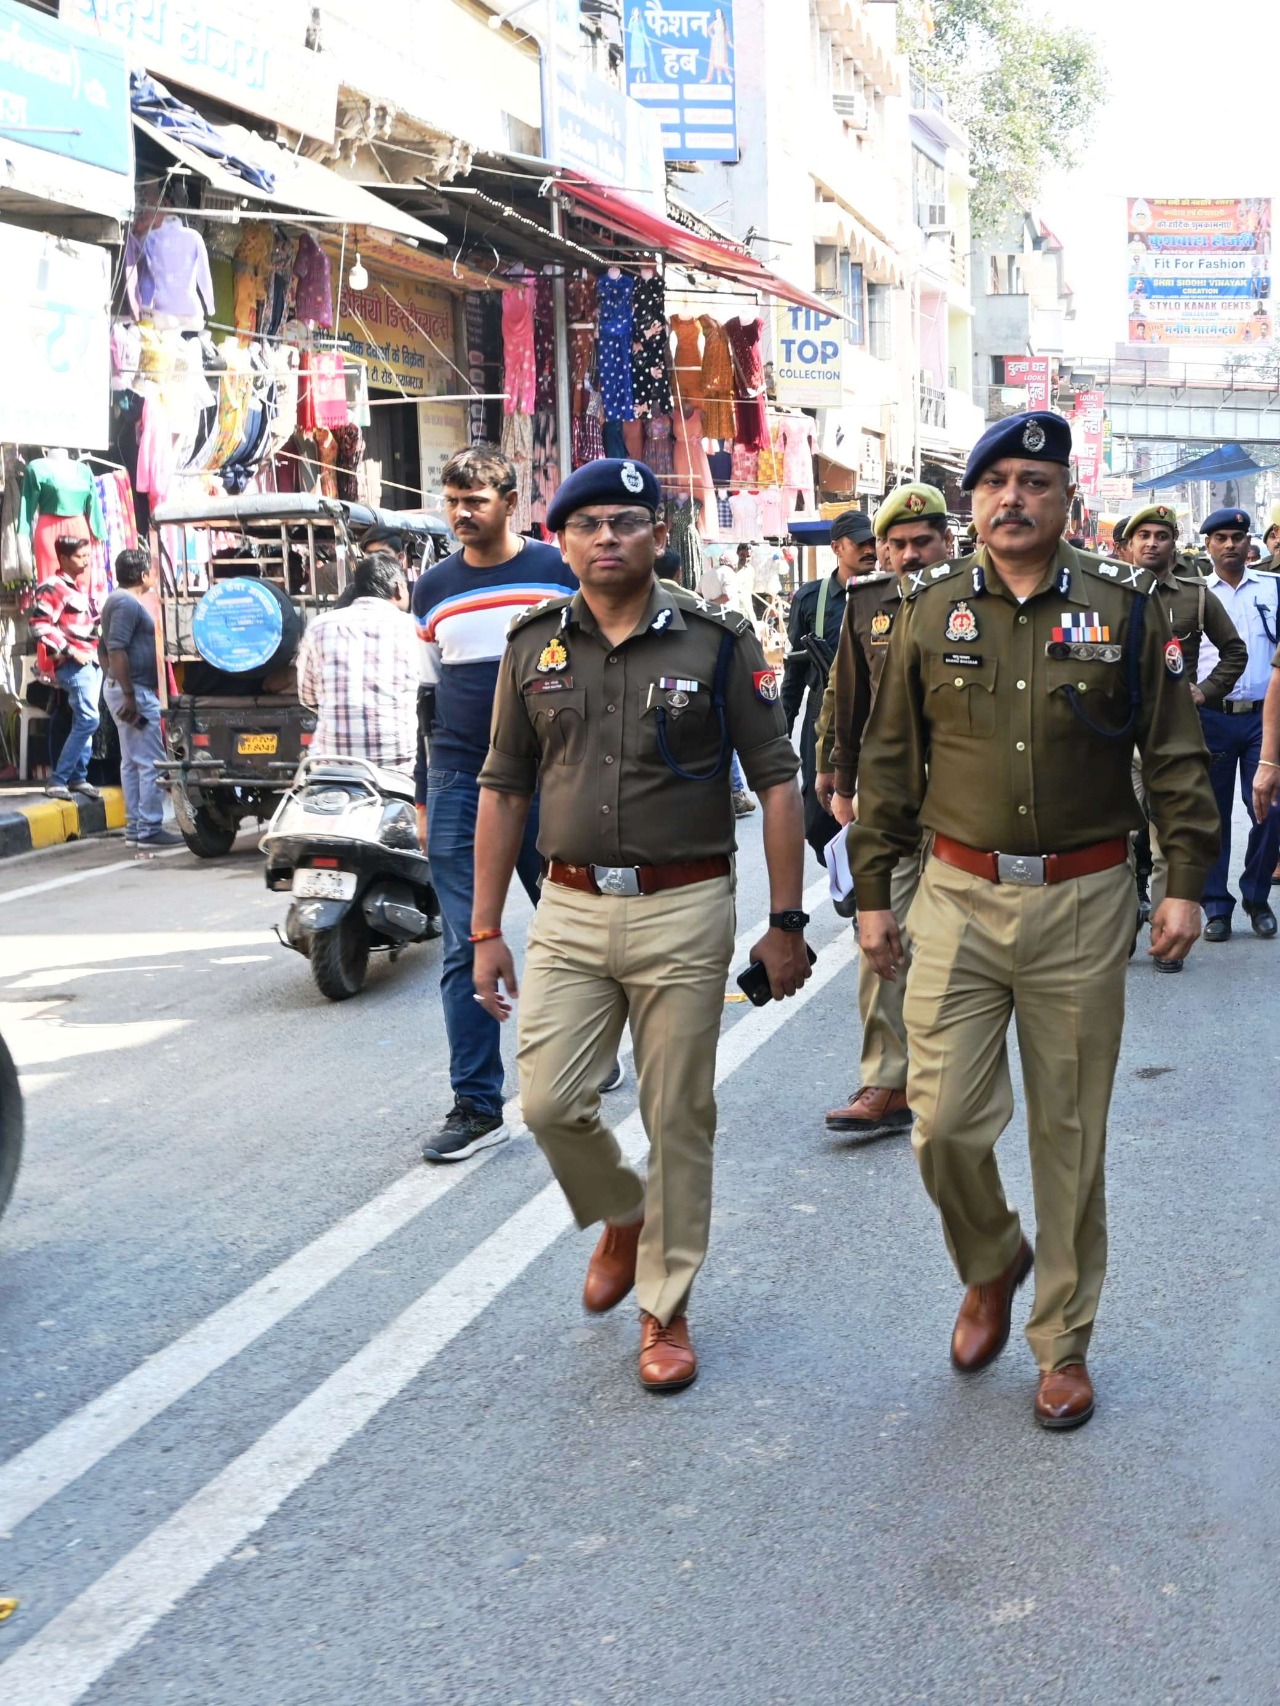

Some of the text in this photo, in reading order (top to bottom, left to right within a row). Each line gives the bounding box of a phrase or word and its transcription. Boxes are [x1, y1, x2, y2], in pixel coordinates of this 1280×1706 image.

[661, 48, 699, 78] हब
[1154, 258, 1246, 269] Fit For Fashion
[1149, 301, 1181, 310] STYLO
[1184, 301, 1217, 310] KANAK
[780, 339, 839, 364] TOP
[779, 369, 840, 380] COLLECTION
